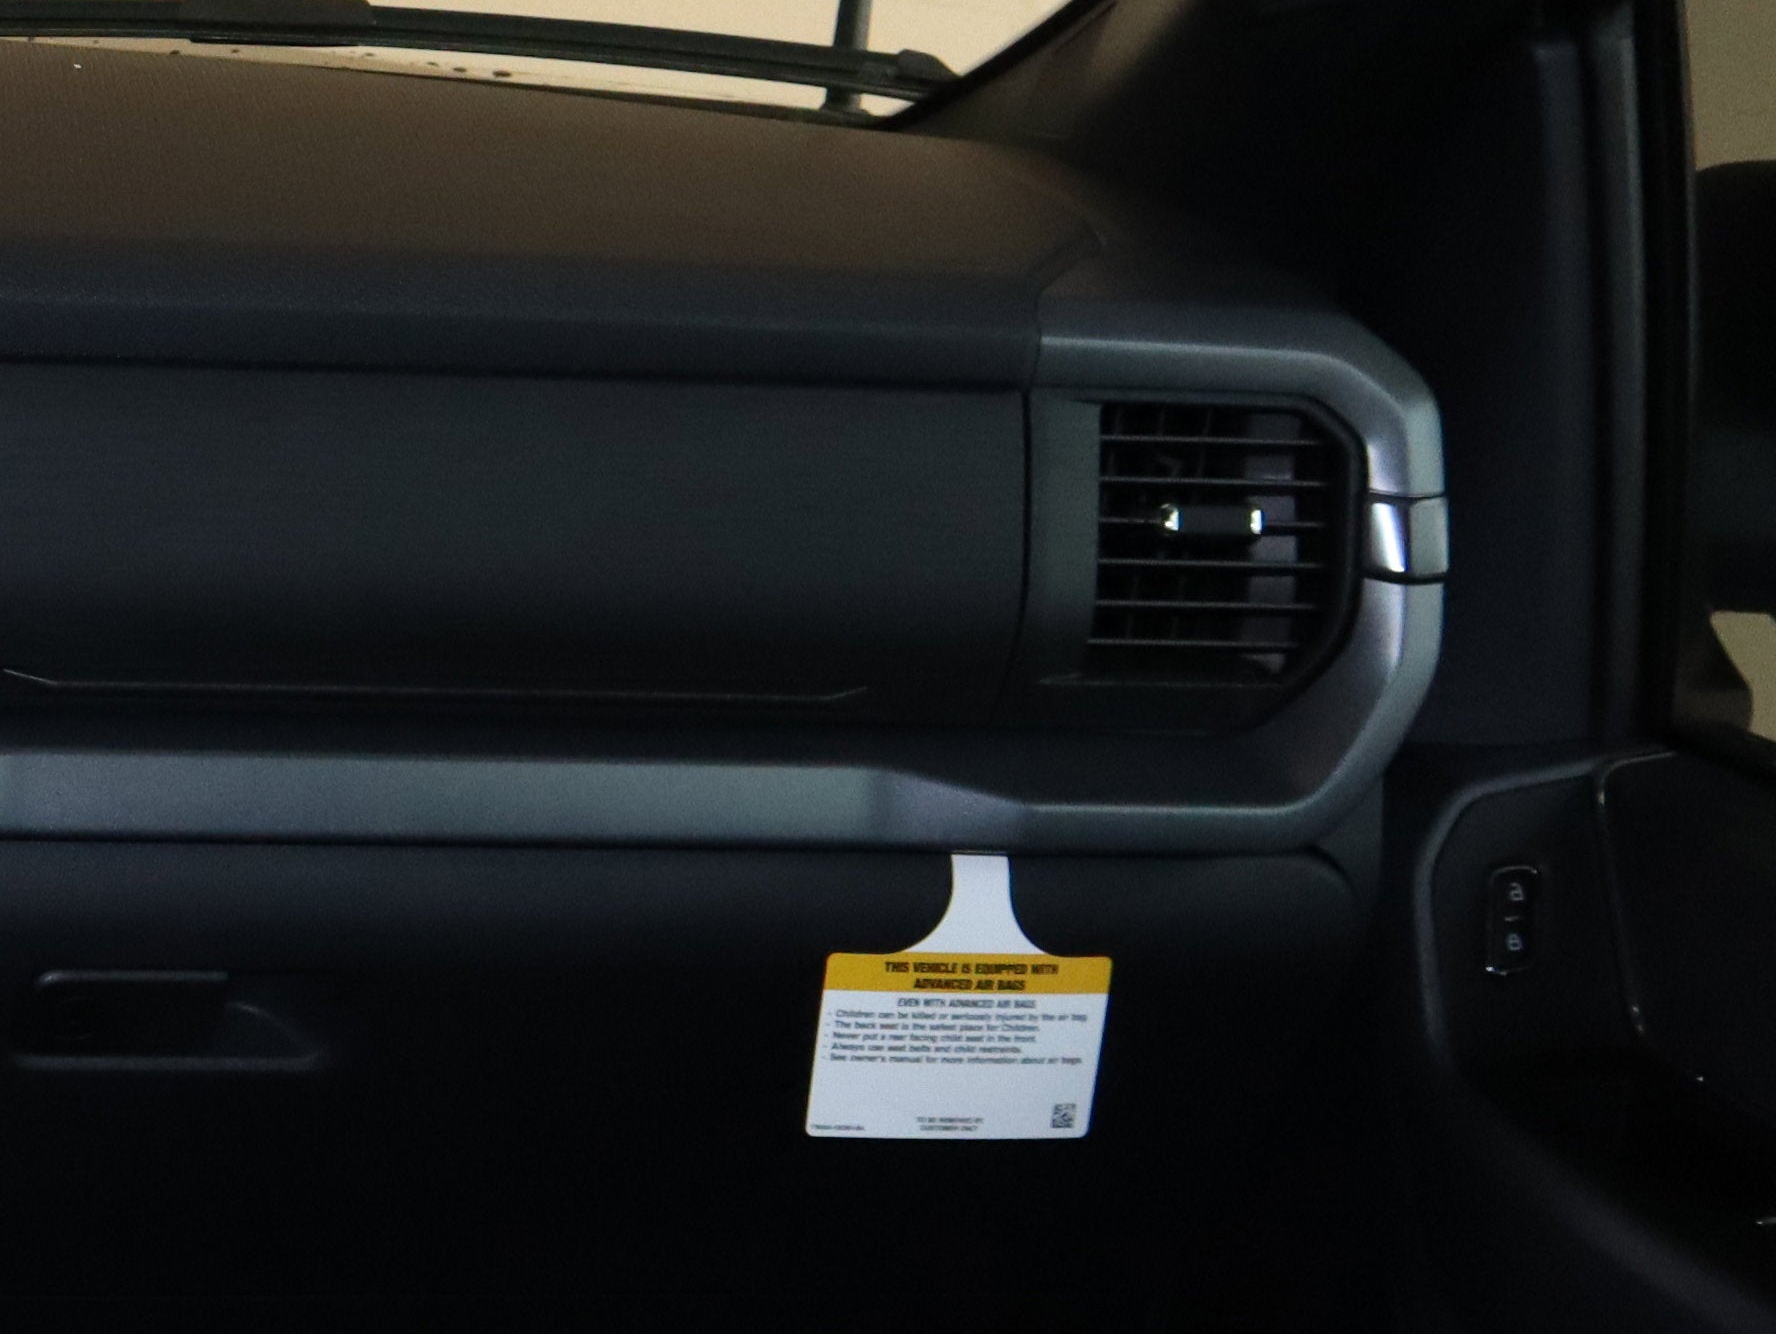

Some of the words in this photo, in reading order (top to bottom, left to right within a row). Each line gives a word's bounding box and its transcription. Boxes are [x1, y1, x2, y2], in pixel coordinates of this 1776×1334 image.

[885, 961, 910, 973] THIS
[913, 962, 958, 974] VEHICLE
[961, 963, 972, 974] IS
[974, 963, 1028, 975] EQUIPPED
[1031, 964, 1059, 975] WITH
[913, 978, 973, 990] ADVANCED
[975, 979, 995, 991] AIR
[997, 979, 1026, 991] BAGS
[897, 997, 921, 1008] EVEN
[923, 998, 946, 1008] WITH
